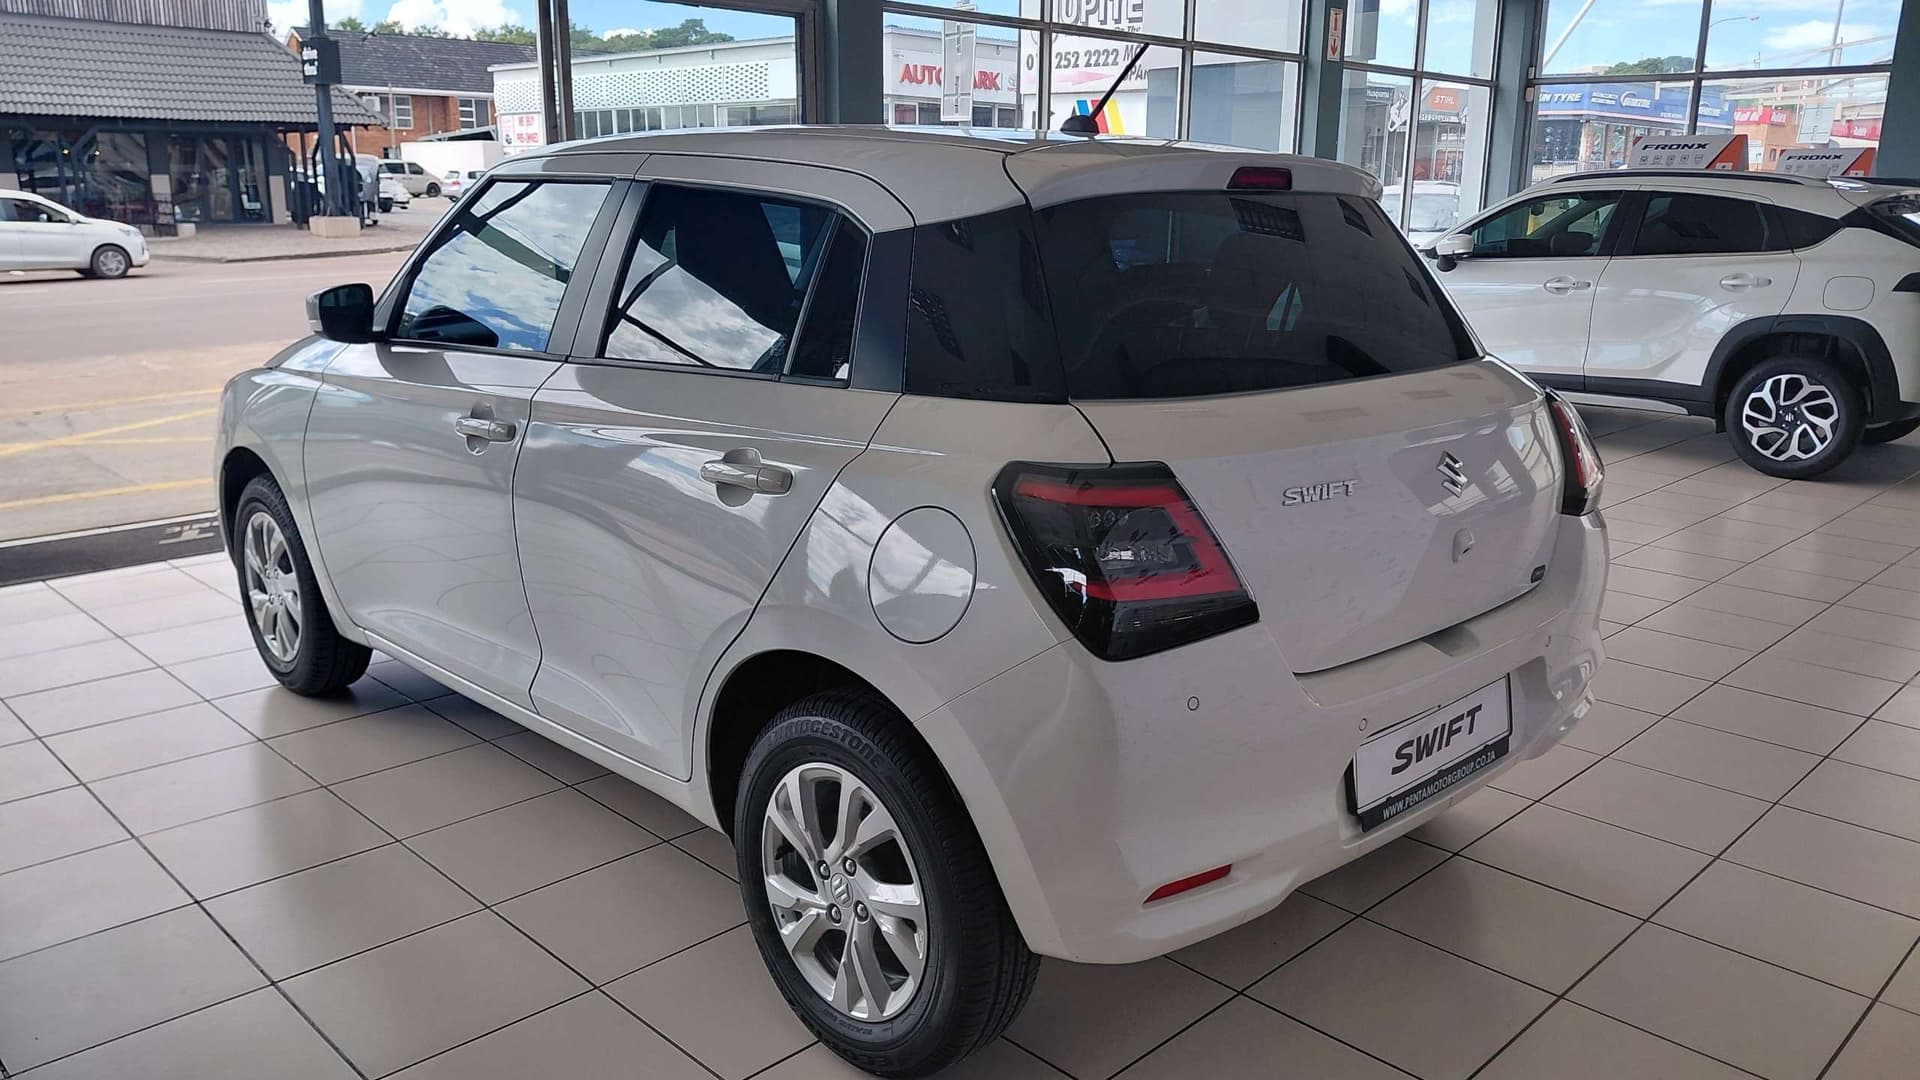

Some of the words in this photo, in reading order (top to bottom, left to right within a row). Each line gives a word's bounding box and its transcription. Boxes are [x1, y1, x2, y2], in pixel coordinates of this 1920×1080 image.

[1055, 51, 1079, 69] 252
[1084, 48, 1119, 68] 2222
[1433, 95, 1455, 104] STIHL
[1554, 92, 1584, 102] TYRE
[1641, 142, 1710, 151] FRONX
[1281, 478, 1358, 507] SWIFT
[1390, 704, 1483, 776] SWIFT
[1382, 750, 1496, 820] WWW.PENTAMOTORGROUP.CO.ZA
